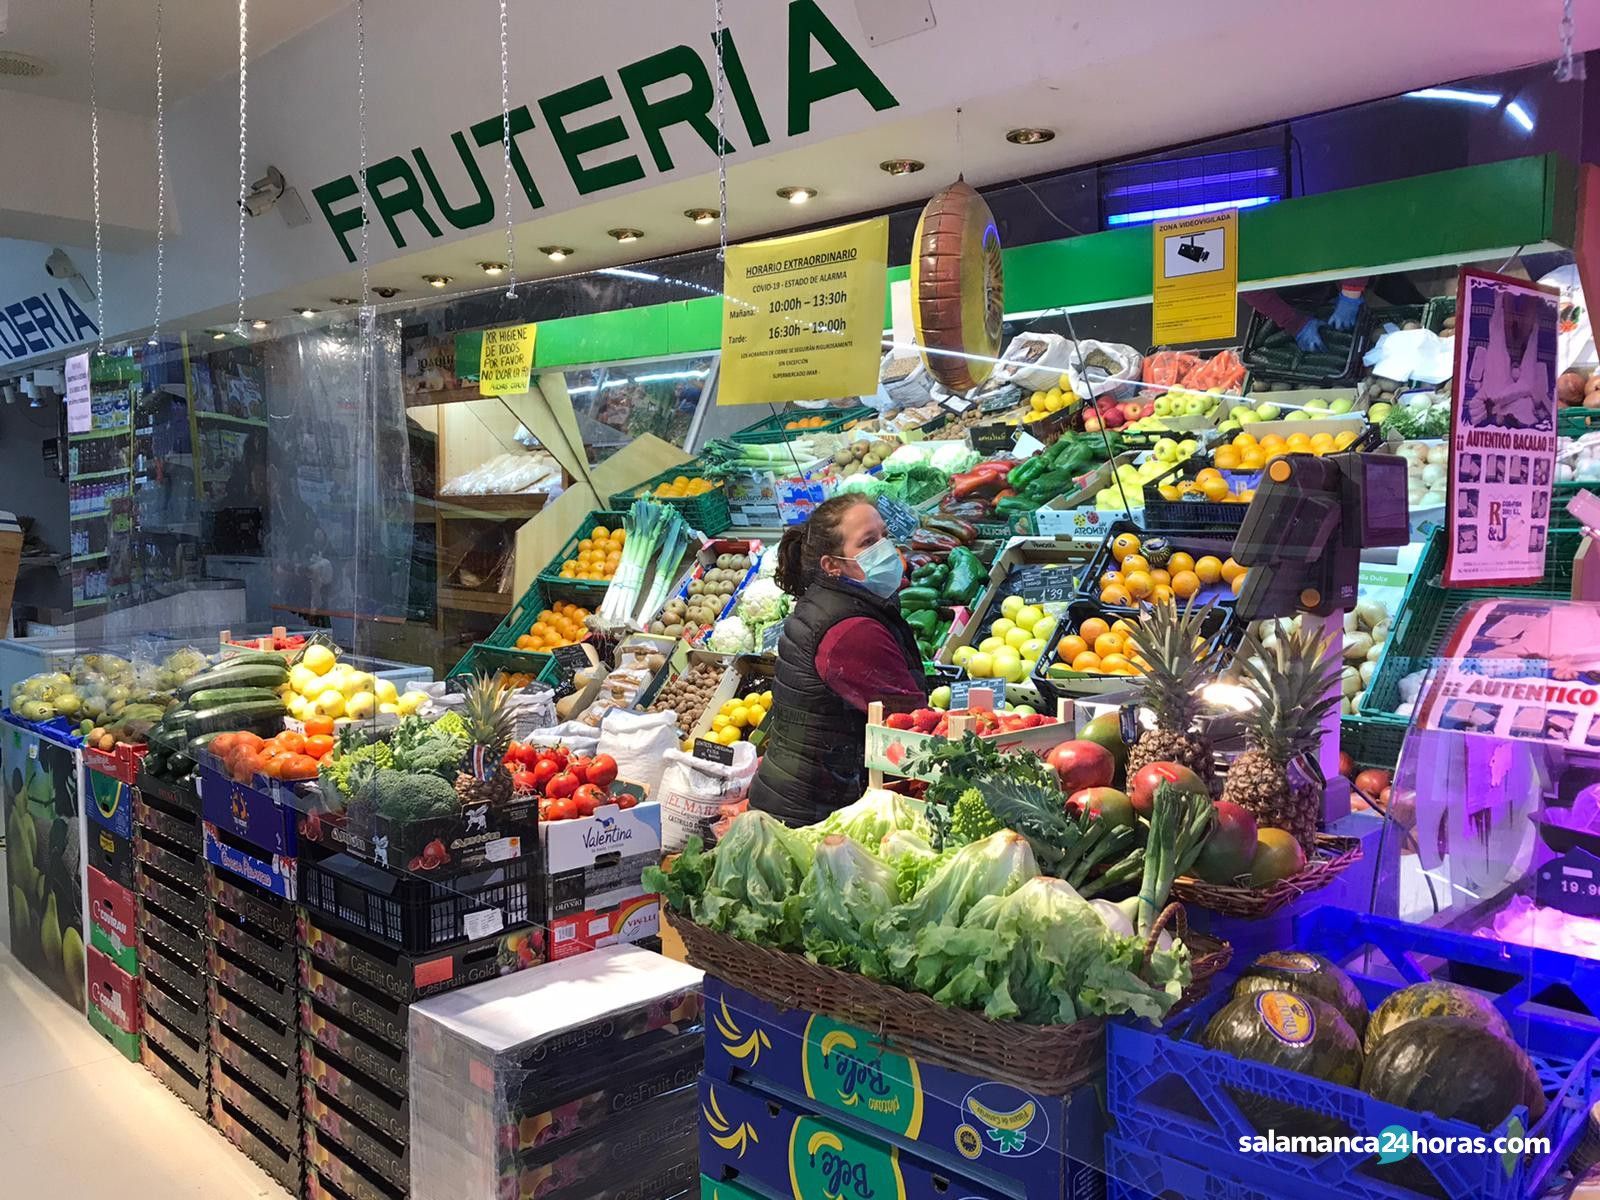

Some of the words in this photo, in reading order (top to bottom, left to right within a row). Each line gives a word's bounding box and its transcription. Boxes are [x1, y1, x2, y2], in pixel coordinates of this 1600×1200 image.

[312, 0, 899, 263] FRUTERIA
[1159, 222, 1178, 231] ZONA
[1179, 214, 1231, 228] VIDEOVIGILADA
[746, 261, 782, 276] HORARIO
[783, 247, 857, 271] EXTRAORDINARIO
[752, 281, 781, 293] COVID-19
[784, 277, 809, 288] ESTADO
[810, 275, 818, 284] DE
[819, 271, 847, 282] ALARMA
[729, 309, 756, 319] Mañana:
[769, 297, 802, 313] 10:00h
[813, 291, 847, 307] 13:30h
[0, 288, 99, 359] DERIA
[728, 335, 748, 345] Tarde:
[769, 324, 801, 339] 16:30h
[486, 331, 497, 344] POR
[500, 328, 527, 342] HIGIENE
[485, 344, 496, 357] DE
[499, 342, 520, 356] TODOS
[484, 358, 498, 370] POR
[501, 354, 525, 367] FAVOR
[481, 370, 493, 381] NO
[1466, 430, 1512, 449] AUTENTICO
[1513, 434, 1548, 452] BACALAO
[1370, 574, 1388, 583] Dulce
[1466, 679, 1599, 706] AUTENTICO
[667, 794, 681, 808] EL
[683, 799, 720, 815] MARA
[583, 825, 633, 849] Valentina
[1561, 880, 1600, 896] 19.9
[350, 955, 384, 982] CesFruit
[386, 973, 409, 1000] Gold
[468, 964, 497, 981] Gold
[352, 1000, 385, 1031] CesFruit
[354, 1046, 388, 1079] CesFruit
[836, 1051, 891, 1095] Bele
[612, 1076, 671, 1111] CesFruit
[355, 1094, 389, 1128] CesFruit
[822, 1150, 875, 1200] Bele
